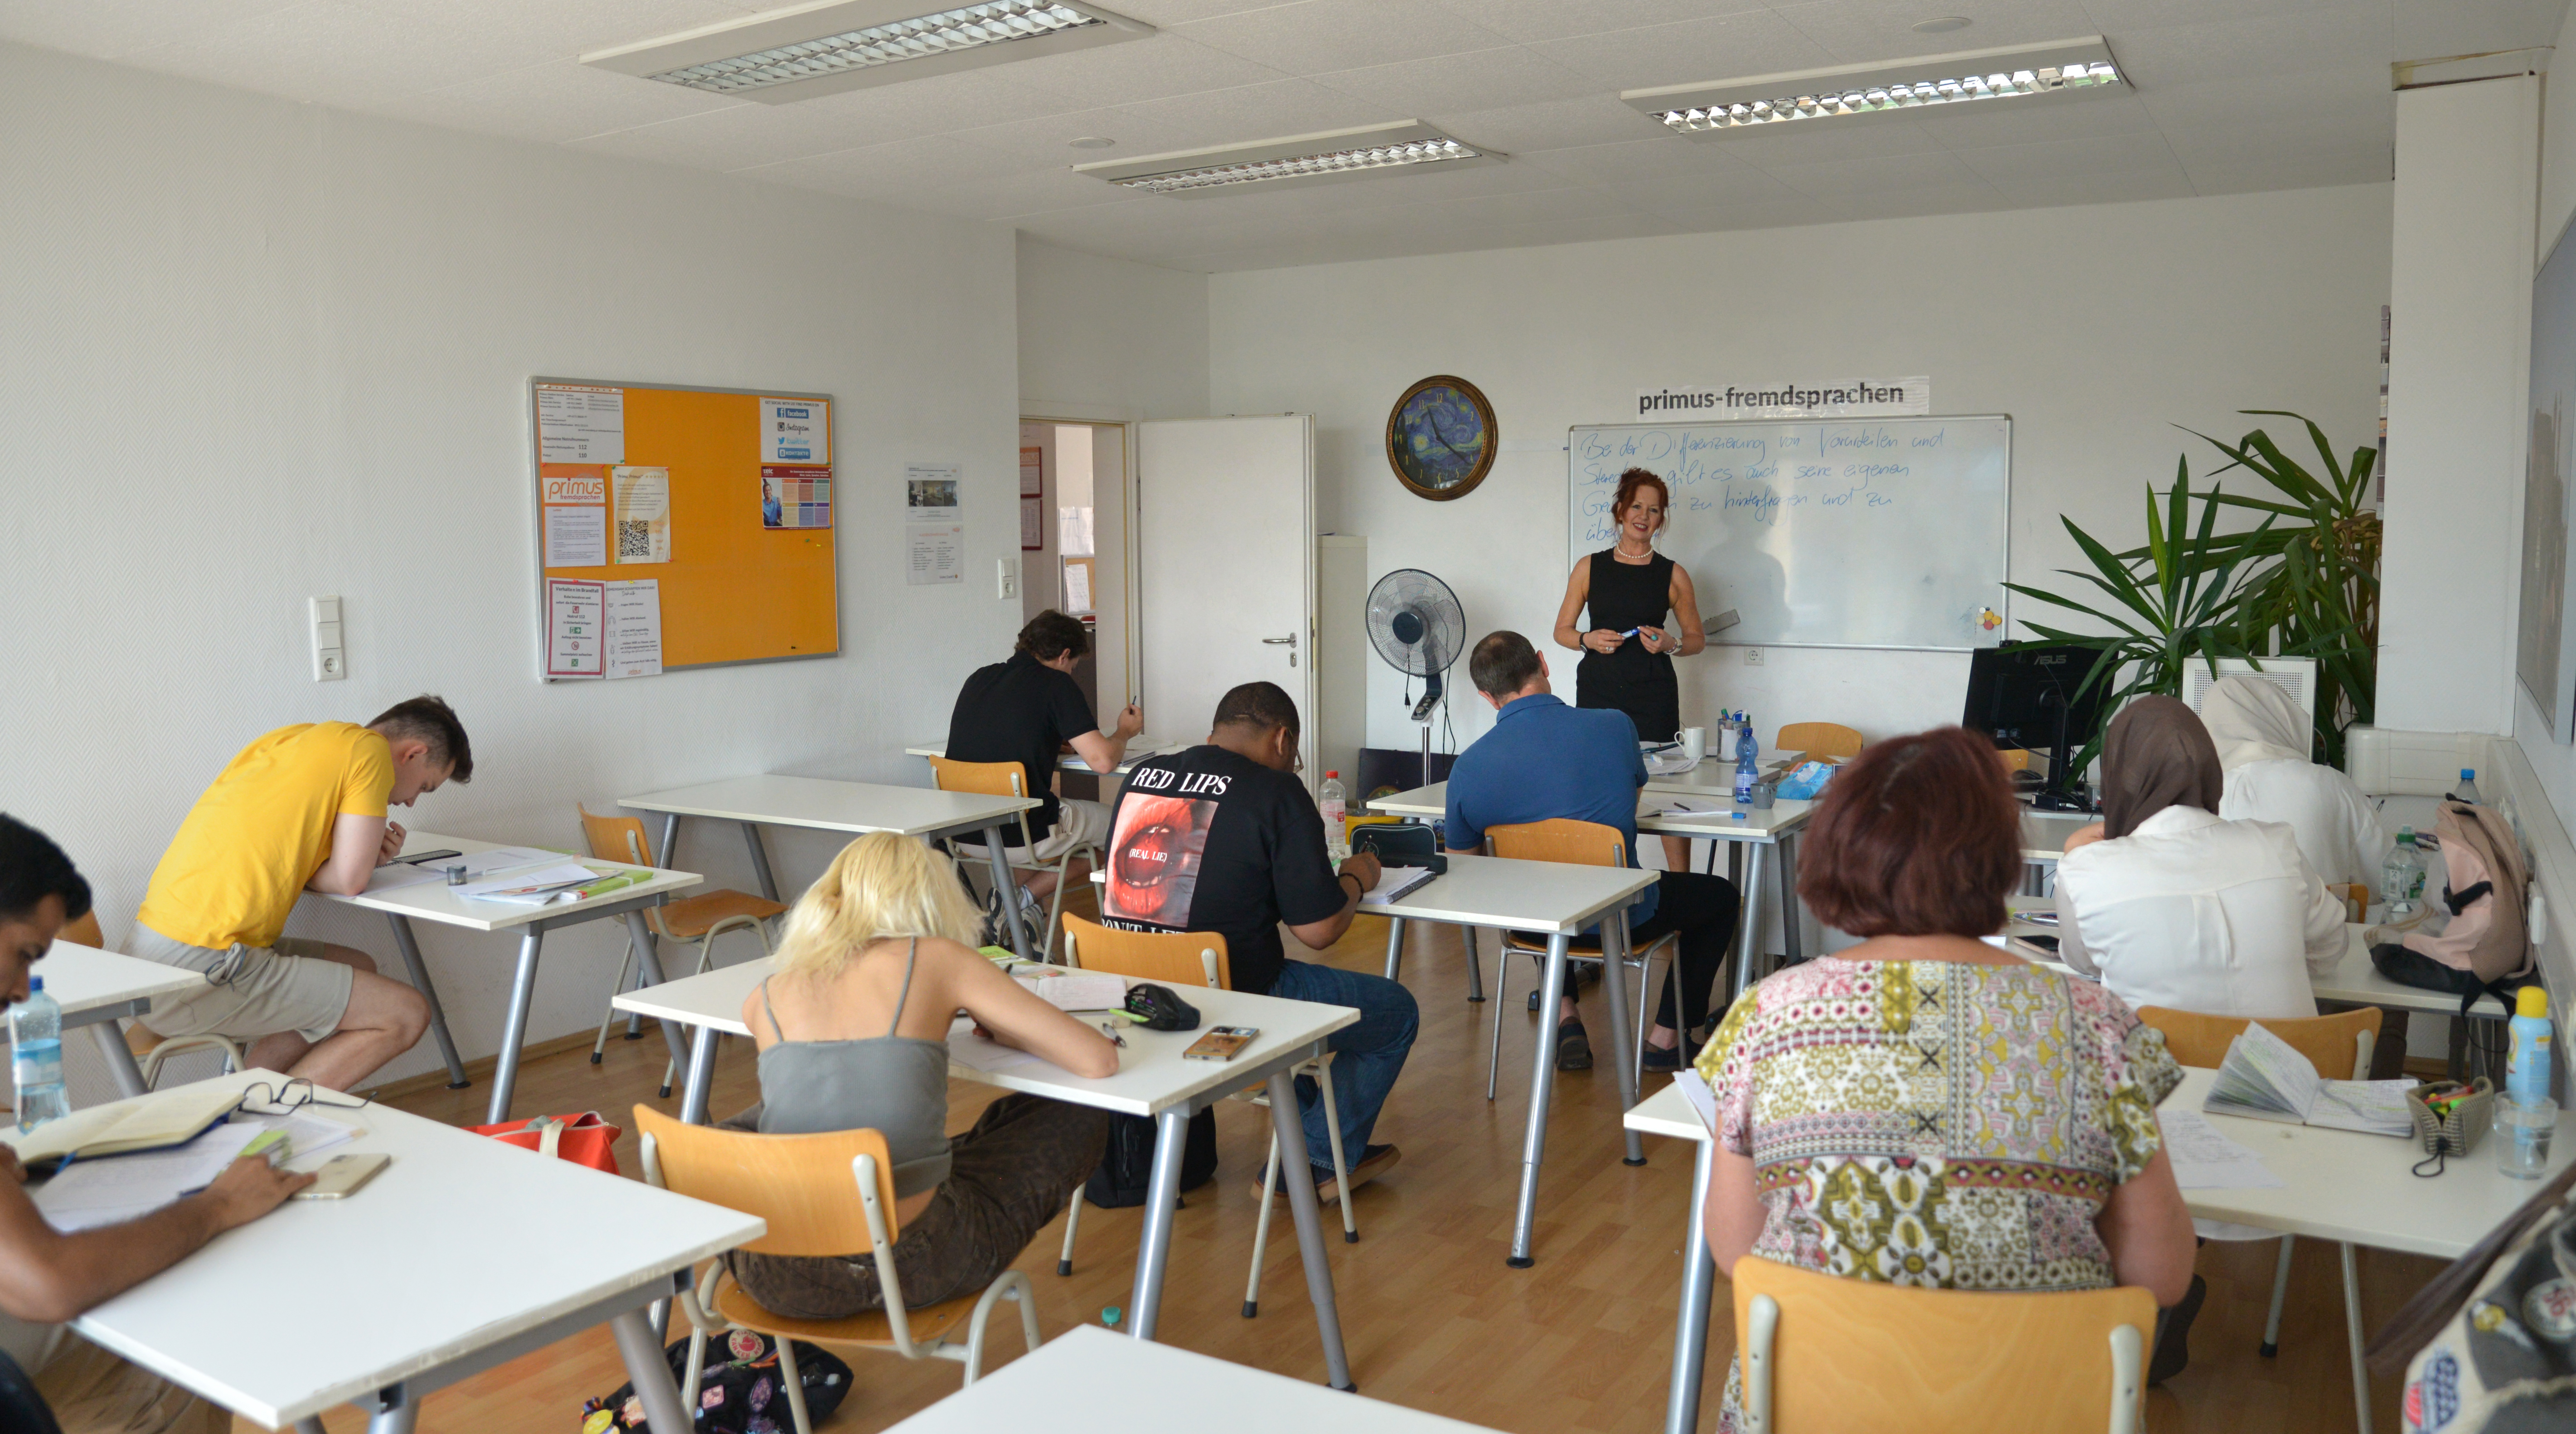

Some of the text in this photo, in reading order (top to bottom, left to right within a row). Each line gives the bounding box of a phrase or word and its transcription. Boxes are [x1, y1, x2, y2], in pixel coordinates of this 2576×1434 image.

[1419, 400, 1424, 409] 11
[1436, 393, 1443, 403] 12
[1640, 383, 1903, 414] primus-fremdsprachen
[1406, 414, 1412, 425] 10
[1470, 411, 1474, 421] 2
[786, 423, 810, 435] Instagram
[1581, 433, 1611, 459] Bei
[1620, 436, 1636, 456] der
[1780, 436, 1800, 448] von
[1912, 428, 1945, 448] und
[1667, 460, 1704, 499] gilt
[1711, 466, 1732, 481] es
[1746, 460, 1778, 480] auch
[1794, 464, 1832, 479] seine
[1844, 464, 1909, 491] eigenen
[549, 478, 603, 499] primus
[1690, 498, 1712, 511] zu
[1822, 487, 1854, 505] und
[1866, 492, 1892, 507] zu
[2034, 655, 2067, 665] ASUS
[1131, 768, 1232, 795] RED LIPS
[1129, 848, 1168, 862] (REAL LIE)
